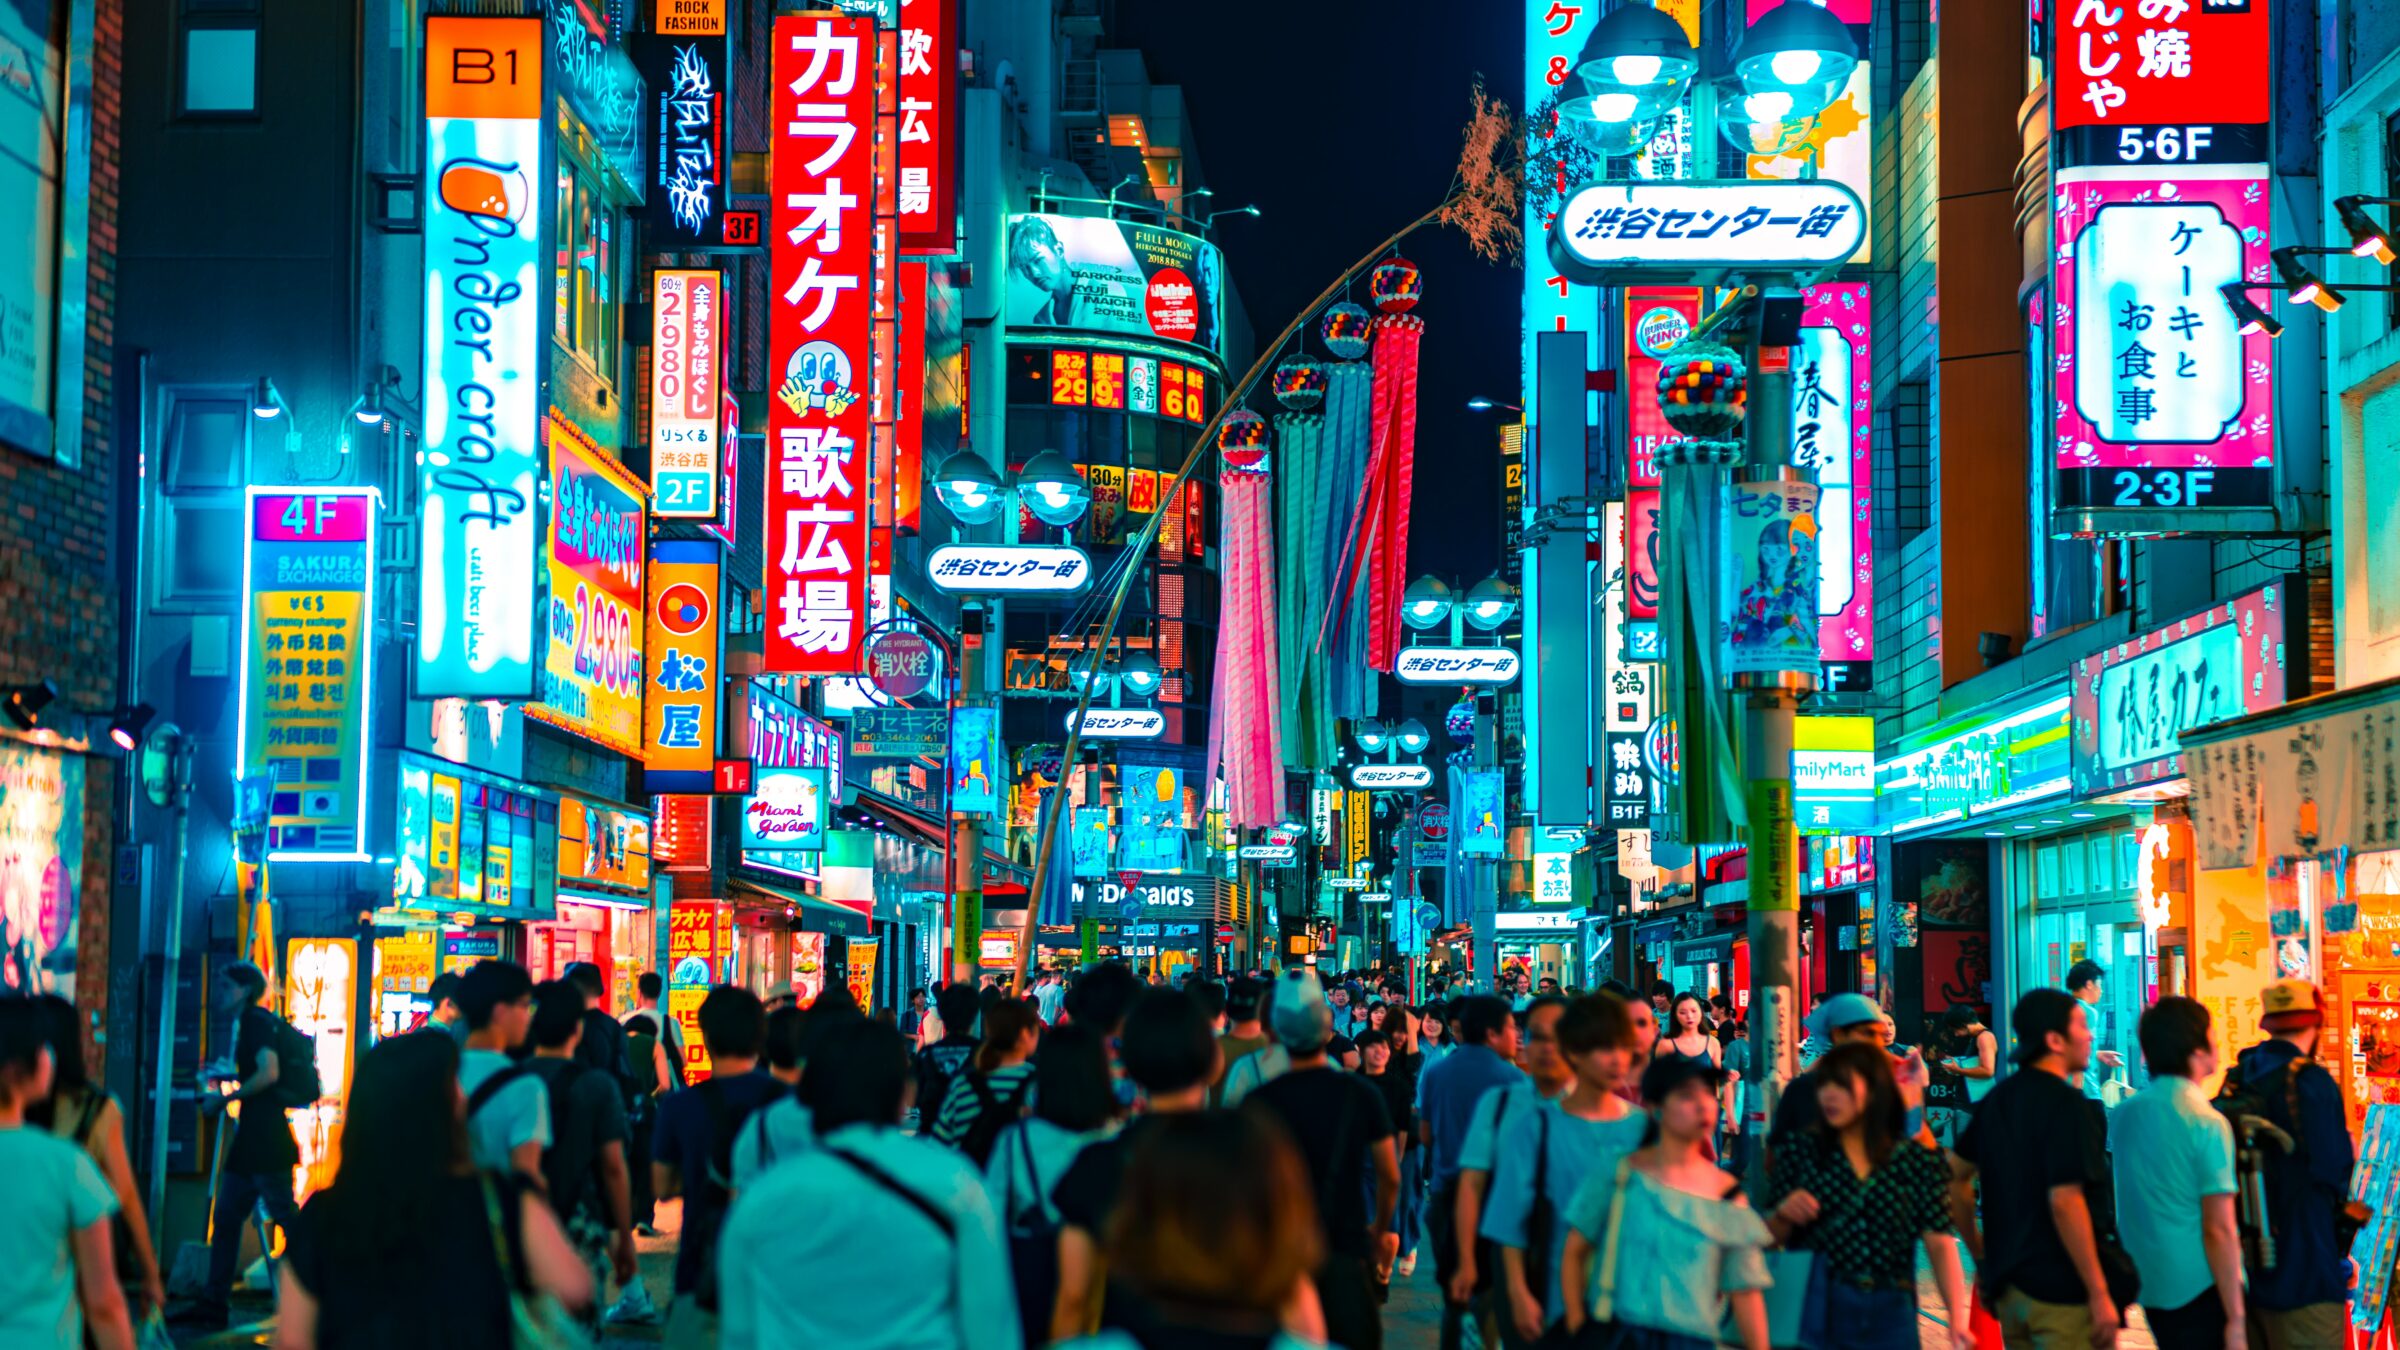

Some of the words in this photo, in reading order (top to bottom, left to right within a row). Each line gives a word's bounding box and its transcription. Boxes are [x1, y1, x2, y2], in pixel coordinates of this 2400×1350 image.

[675, 1, 709, 13] ROCK
[665, 17, 719, 31] FASHION
[452, 48, 518, 85] B1
[784, 20, 859, 333] カラオケ
[729, 218, 755, 240] 3F
[1575, 205, 1850, 239] 渋谷センター街
[1135, 231, 1161, 245] FULL
[1165, 235, 1193, 252] MOON
[661, 278, 682, 290] 60分
[1071, 271, 1143, 285] DARKNESS
[1083, 295, 1136, 308] IMAICHI
[2168, 221, 2204, 378] ケーキと
[1093, 307, 1142, 320] 2018.8.1
[1644, 319, 1681, 334] BURGER
[1646, 328, 1683, 346] KING
[691, 284, 712, 413] 全身もみほぐし
[2116, 300, 2157, 425] お食事
[661, 429, 708, 442] りらくる
[660, 452, 709, 468] 渋谷店
[1092, 468, 1122, 486] 30分
[665, 479, 705, 503] 2F
[1092, 487, 1121, 503] 飲み
[281, 495, 338, 535] 4F
[557, 466, 640, 589] 全身もみほぐし
[778, 426, 855, 655] 歌広場
[277, 555, 365, 571] SAKURA
[936, 558, 1081, 578] 渋谷センター街
[277, 571, 351, 583] EXCHANGE
[266, 618, 304, 629] currency
[305, 617, 346, 628] exchange
[879, 640, 892, 648] FIRE
[894, 639, 923, 648] HYDRANT
[874, 651, 929, 678] 消火栓
[1403, 658, 1515, 672] 渋谷センター街
[1612, 670, 1645, 696] 鍋
[656, 648, 707, 749] 松屋
[723, 766, 747, 790] 1F
[1357, 771, 1427, 781] 渋谷センター街
[745, 801, 804, 816] Miami
[1612, 805, 1645, 819] B1F
[1813, 805, 1830, 824] 酒
[1316, 814, 1328, 844] 牛タン
[1071, 883, 1195, 907] MDald's
[670, 930, 711, 950] 広場
